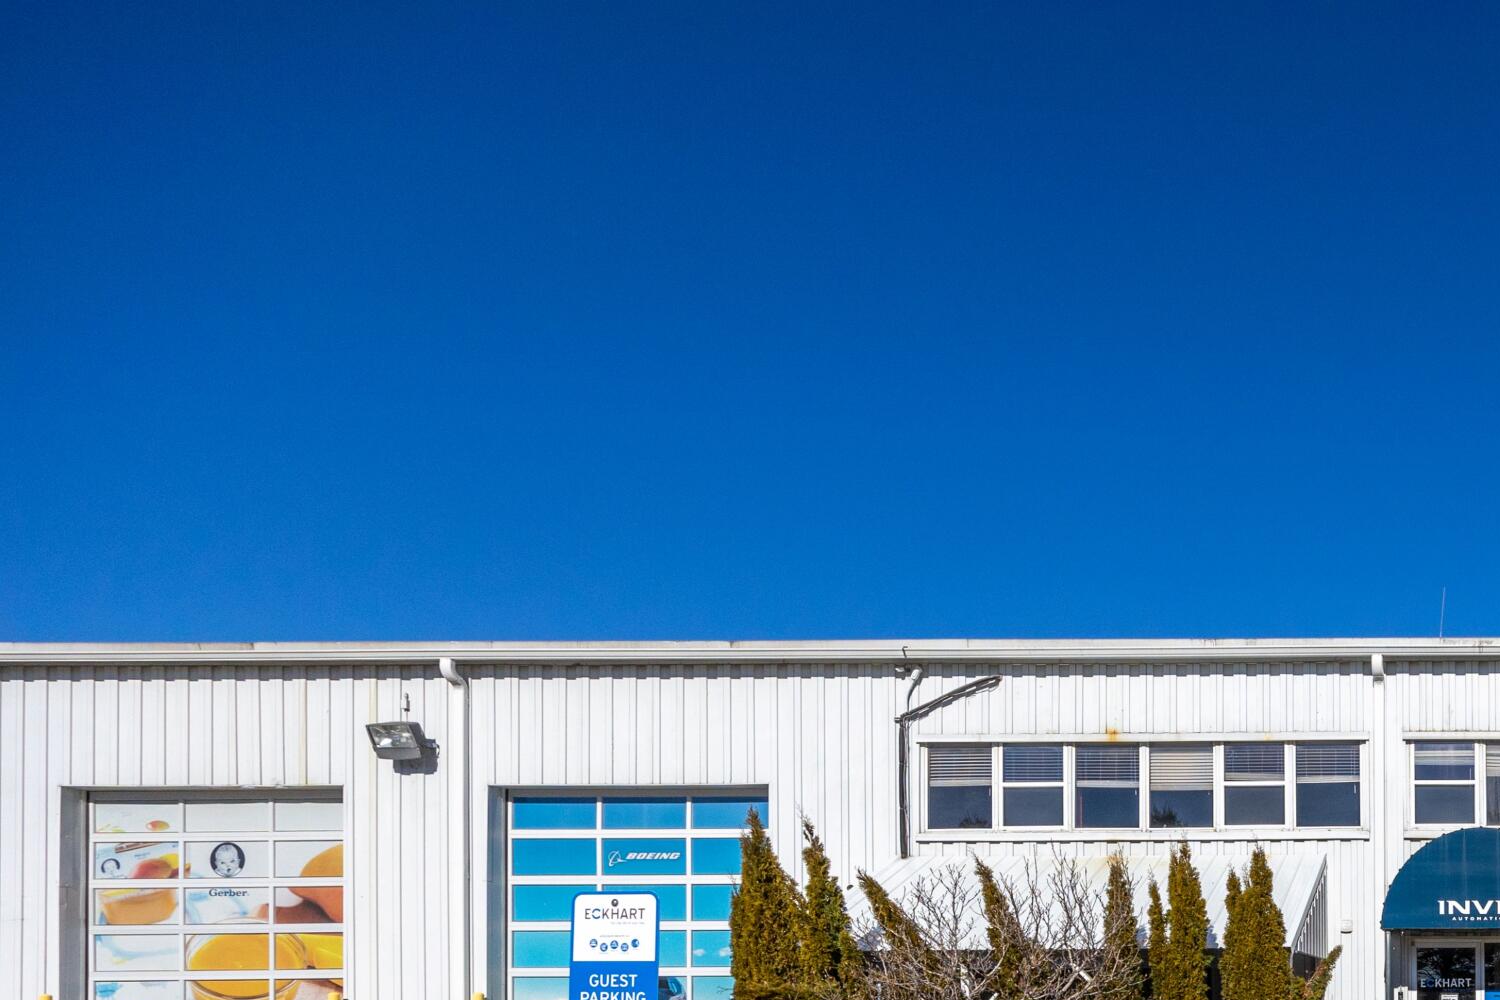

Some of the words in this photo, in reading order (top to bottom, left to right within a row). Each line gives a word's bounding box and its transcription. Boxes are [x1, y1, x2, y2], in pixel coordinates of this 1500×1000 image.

[626, 851, 681, 861] BOEING
[208, 888, 248, 897] Gerber
[584, 907, 646, 920] ECKHART
[588, 974, 639, 988] GUEST
[1420, 977, 1472, 988] ECKHART
